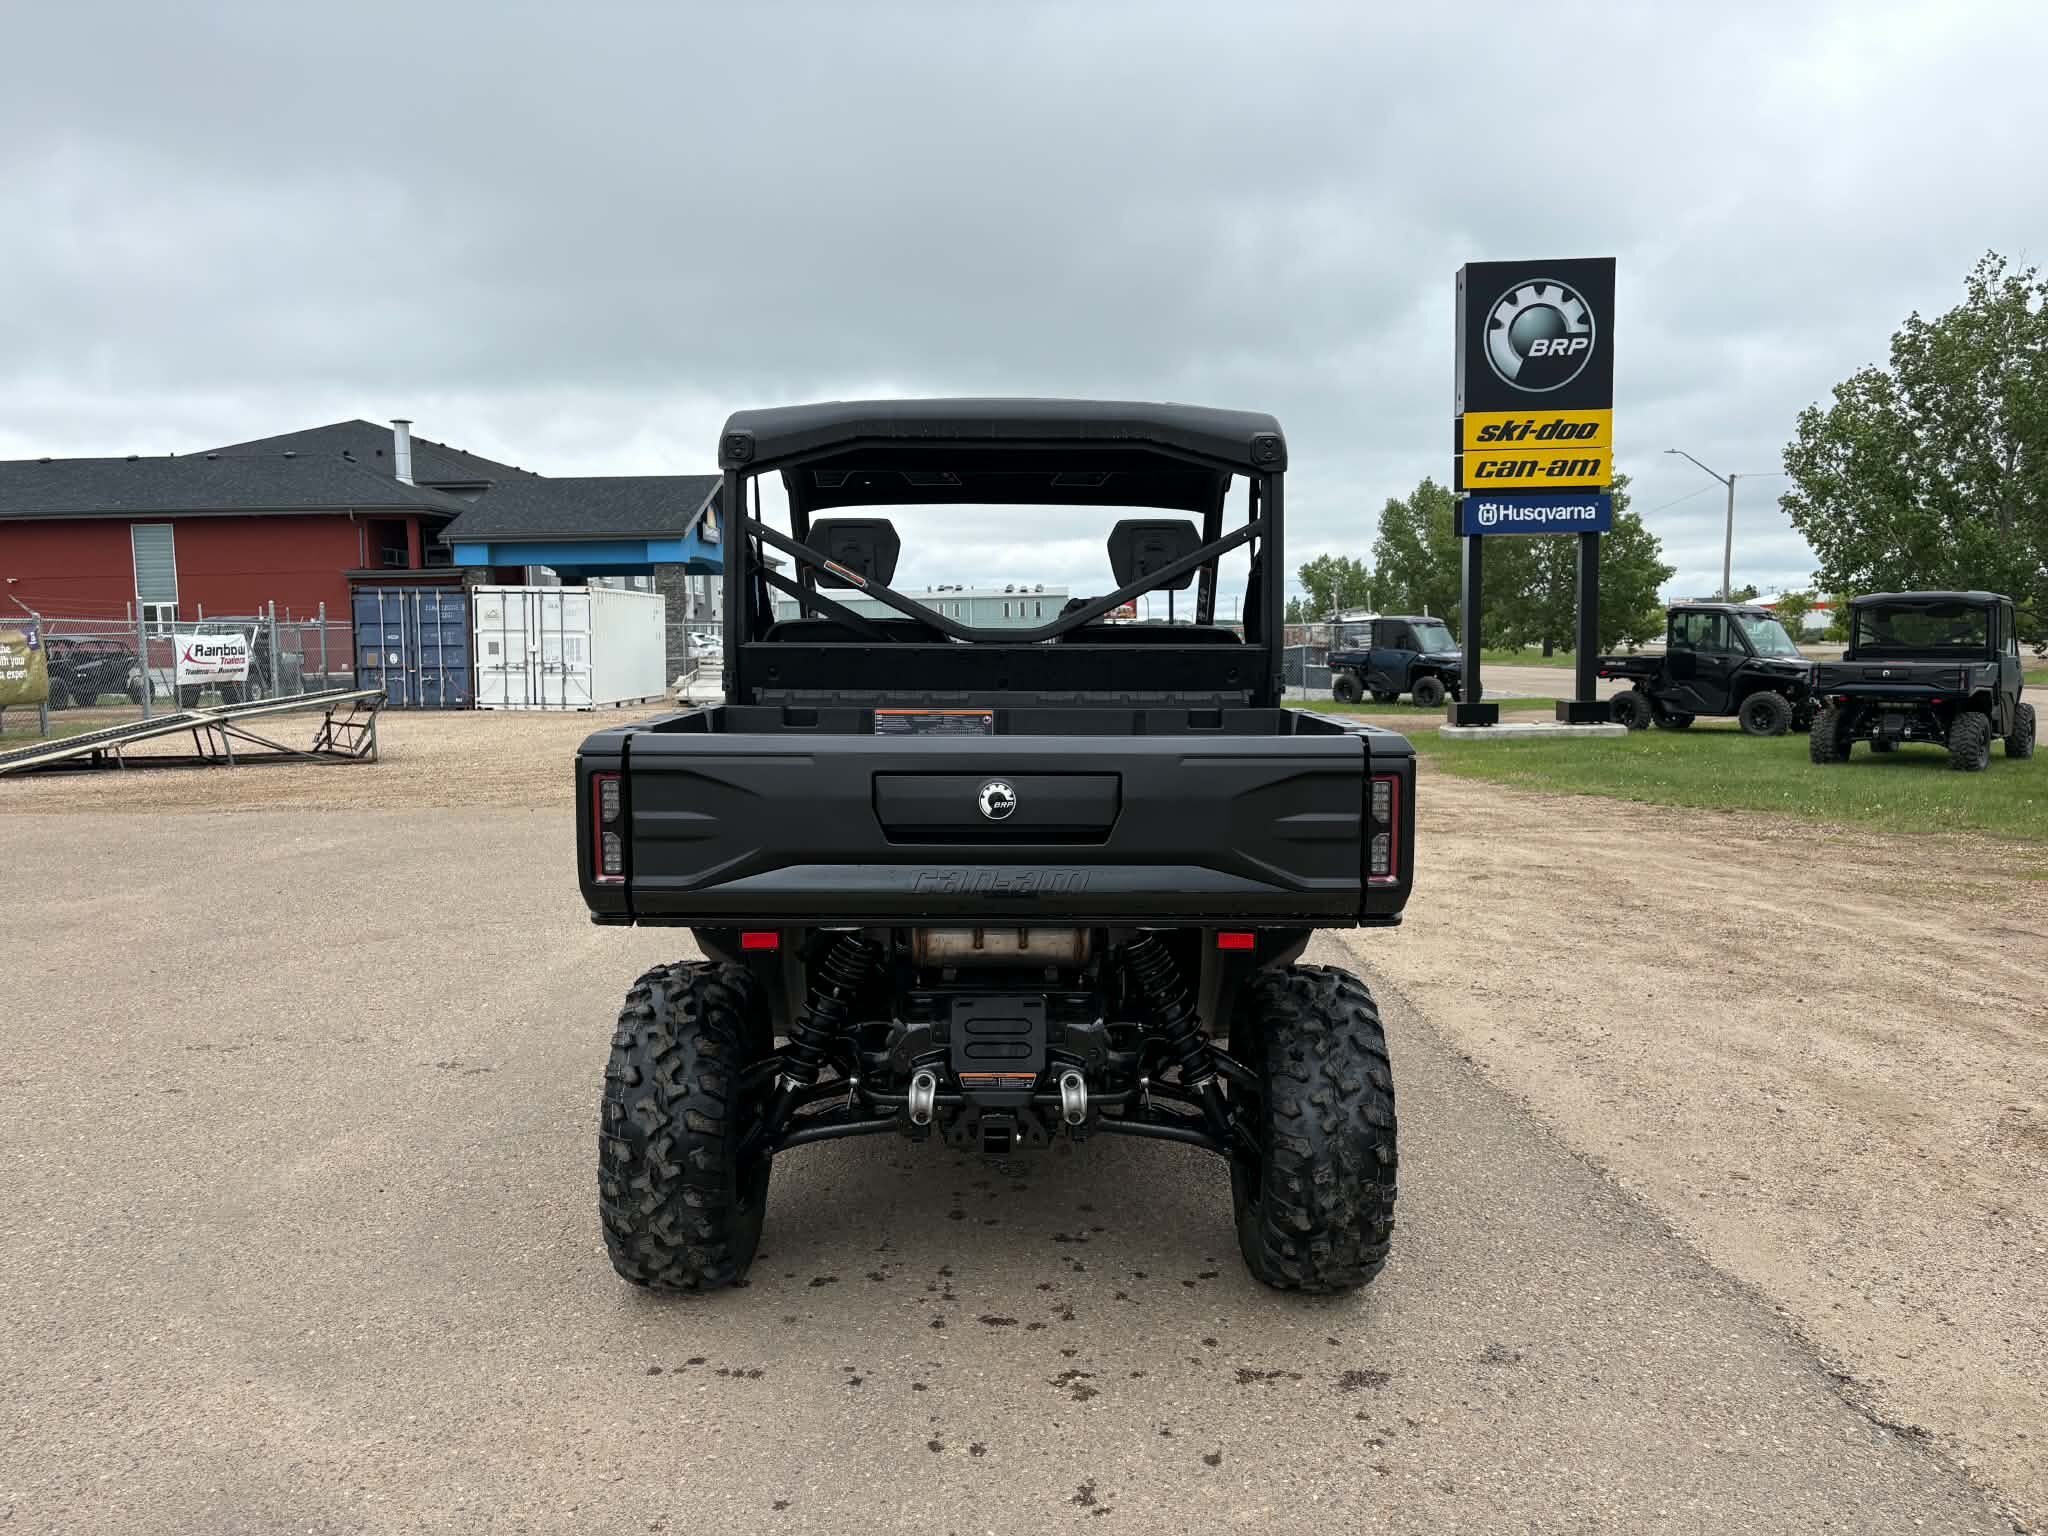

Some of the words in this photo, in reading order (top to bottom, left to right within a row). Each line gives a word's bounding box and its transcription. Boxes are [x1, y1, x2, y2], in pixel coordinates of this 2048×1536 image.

[1528, 337, 1588, 357] BRP
[1476, 419, 1600, 441] ski-doo
[1475, 459, 1601, 478] can-am
[1500, 503, 1596, 524] Husqvarna
[195, 644, 246, 656] Rainbow
